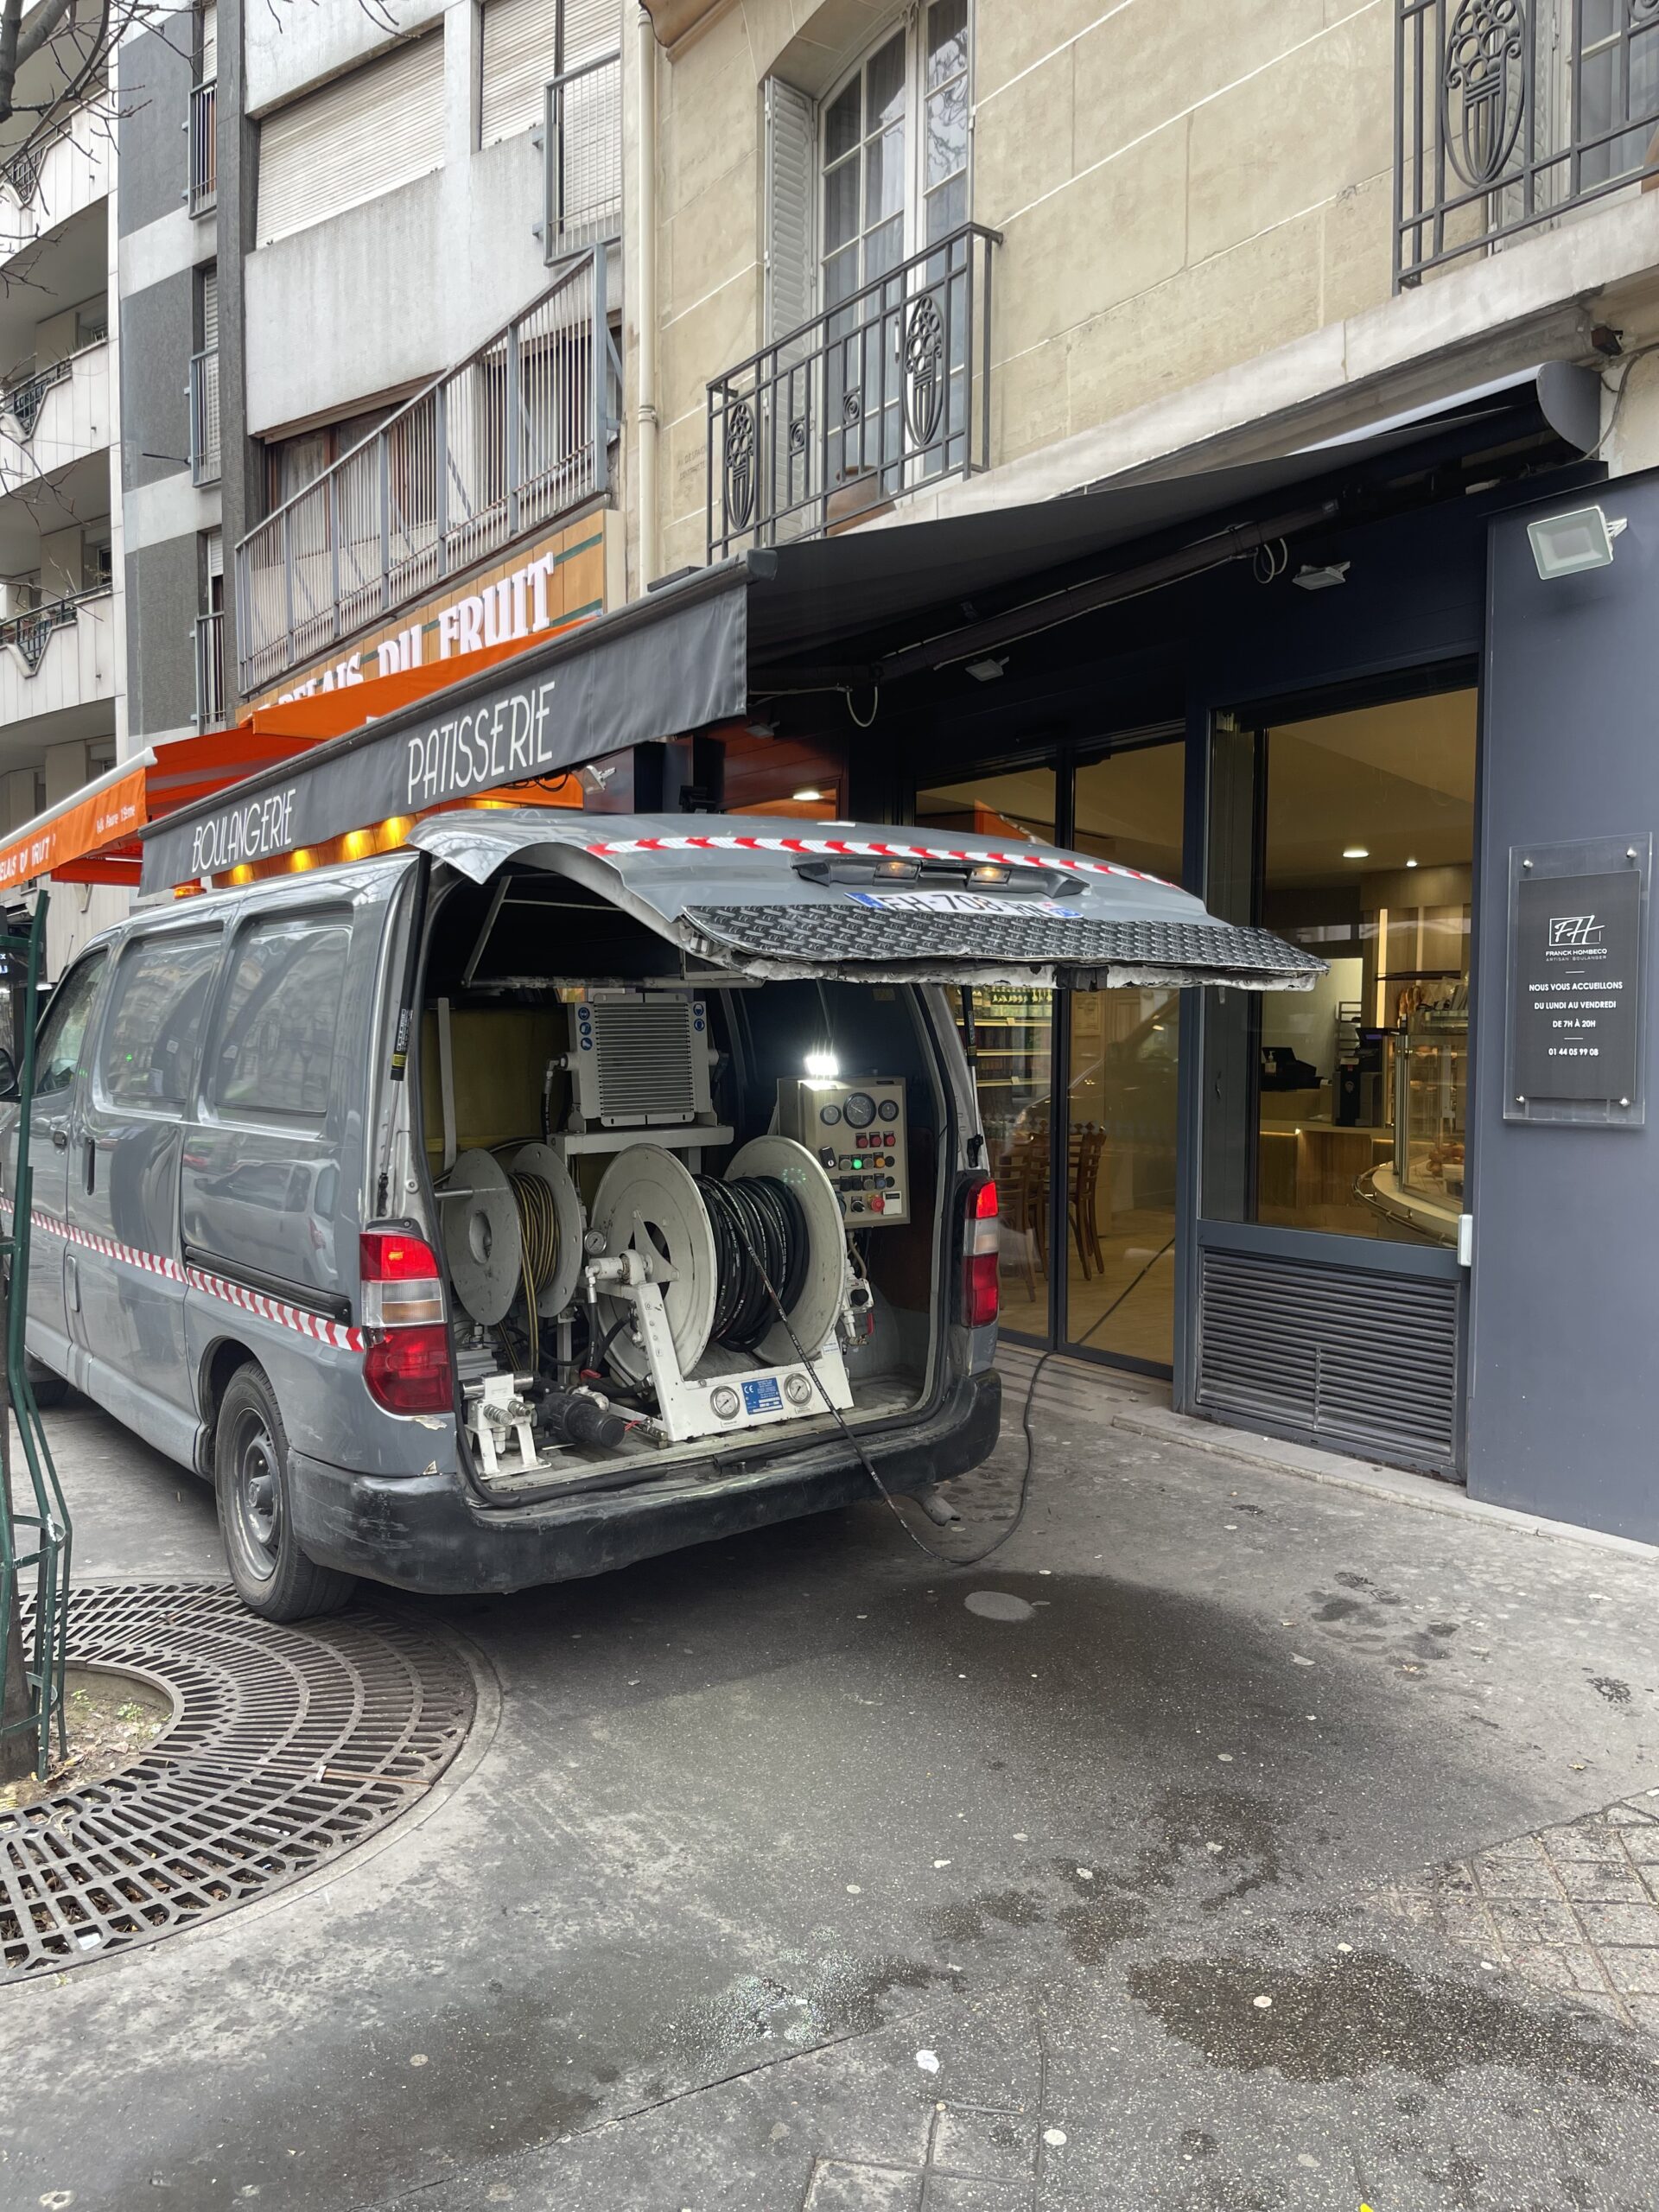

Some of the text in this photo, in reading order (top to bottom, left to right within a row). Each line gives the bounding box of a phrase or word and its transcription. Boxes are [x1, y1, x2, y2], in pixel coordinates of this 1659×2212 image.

[439, 551, 554, 659] FRUIT
[408, 681, 556, 805] PATISSERIE
[192, 788, 296, 873] BOULANGERIE
[1550, 982, 1571, 991] VOUS
[1572, 982, 1624, 990] ACCUEILLONS
[1574, 1018, 1580, 1028] À
[1581, 1020, 1596, 1028] 20H
[744, 1384, 754, 1394] CE
